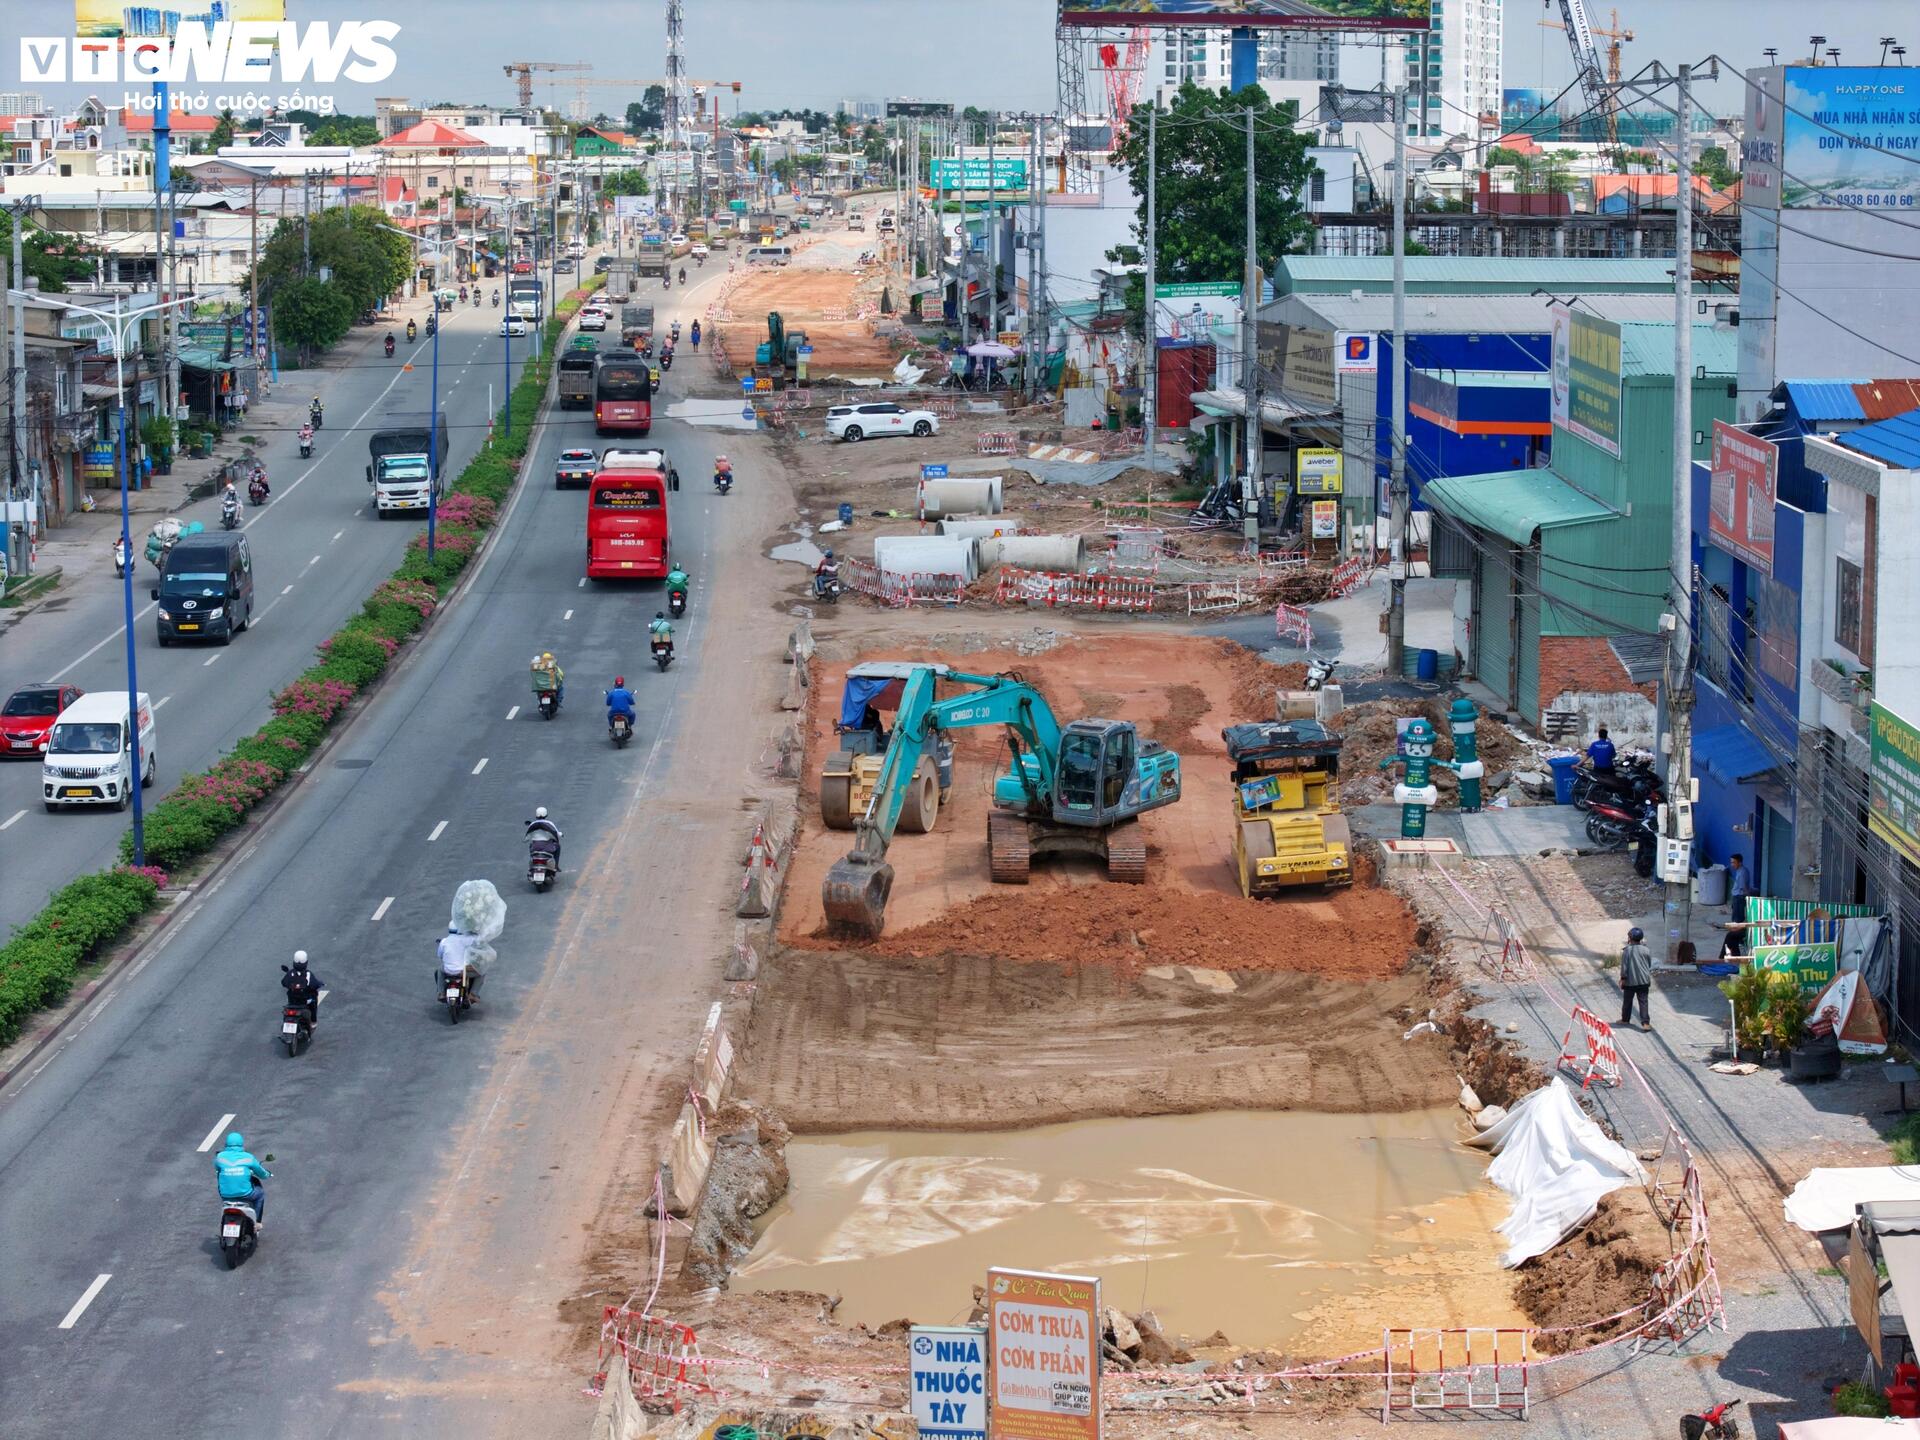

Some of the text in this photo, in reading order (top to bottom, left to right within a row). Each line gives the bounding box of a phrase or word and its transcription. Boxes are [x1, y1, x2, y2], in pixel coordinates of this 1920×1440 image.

[1836, 85, 1904, 94] HAPPY ONE
[1813, 112, 1840, 125] MUA
[1843, 108, 1867, 125] NHÀ
[1872, 108, 1904, 128] NHẬN
[1819, 133, 1919, 152] DỌN VÀO Ở NGAY
[1837, 195, 1913, 206] 0938 60 40 60
[1763, 946, 1830, 968] Cà Phê
[1800, 968, 1828, 982] Thu
[999, 1309, 1085, 1340] CƠM TRƯA
[936, 1338, 981, 1363] NHÀ
[1000, 1343, 1086, 1376] CƠM PHẦN
[914, 1366, 982, 1394] THUỐC
[930, 1399, 967, 1424] TÂY
